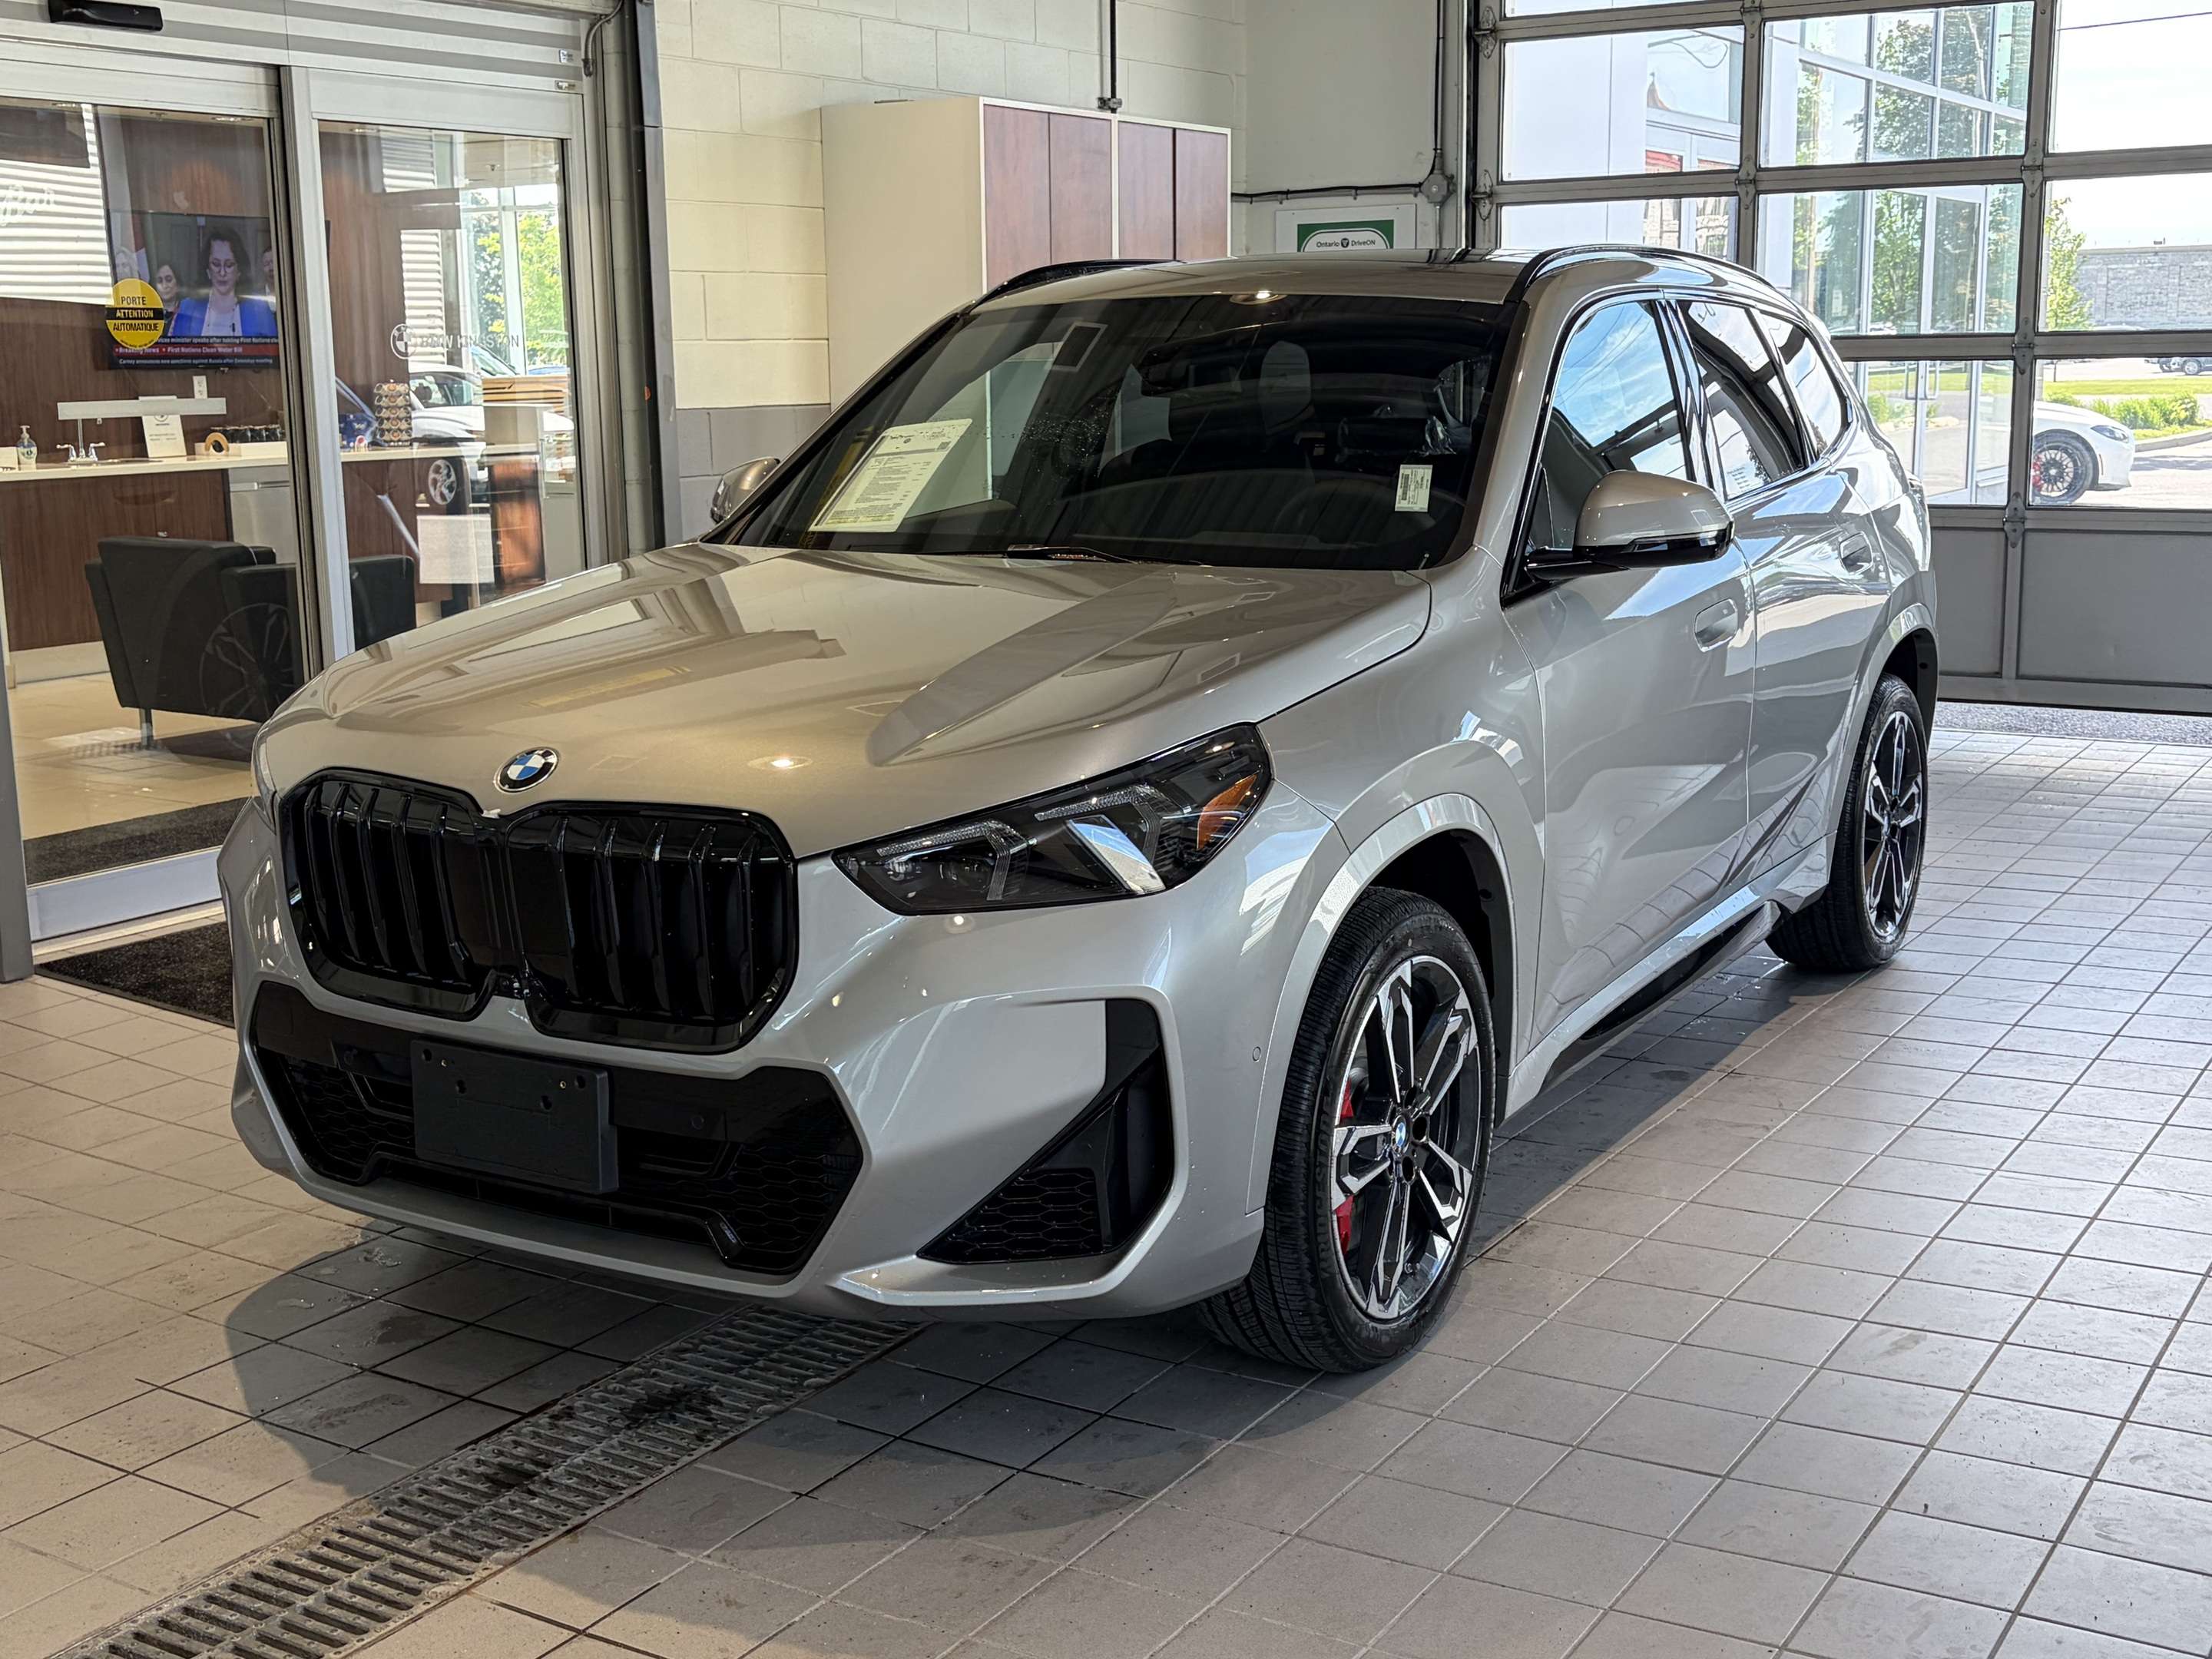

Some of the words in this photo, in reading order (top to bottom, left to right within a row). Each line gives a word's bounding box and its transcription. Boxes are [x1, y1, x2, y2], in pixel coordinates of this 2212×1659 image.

[121, 296, 147, 306] PORTE
[116, 309, 154, 318] ATTENTION
[113, 323, 159, 333] AUTOMATIQUE
